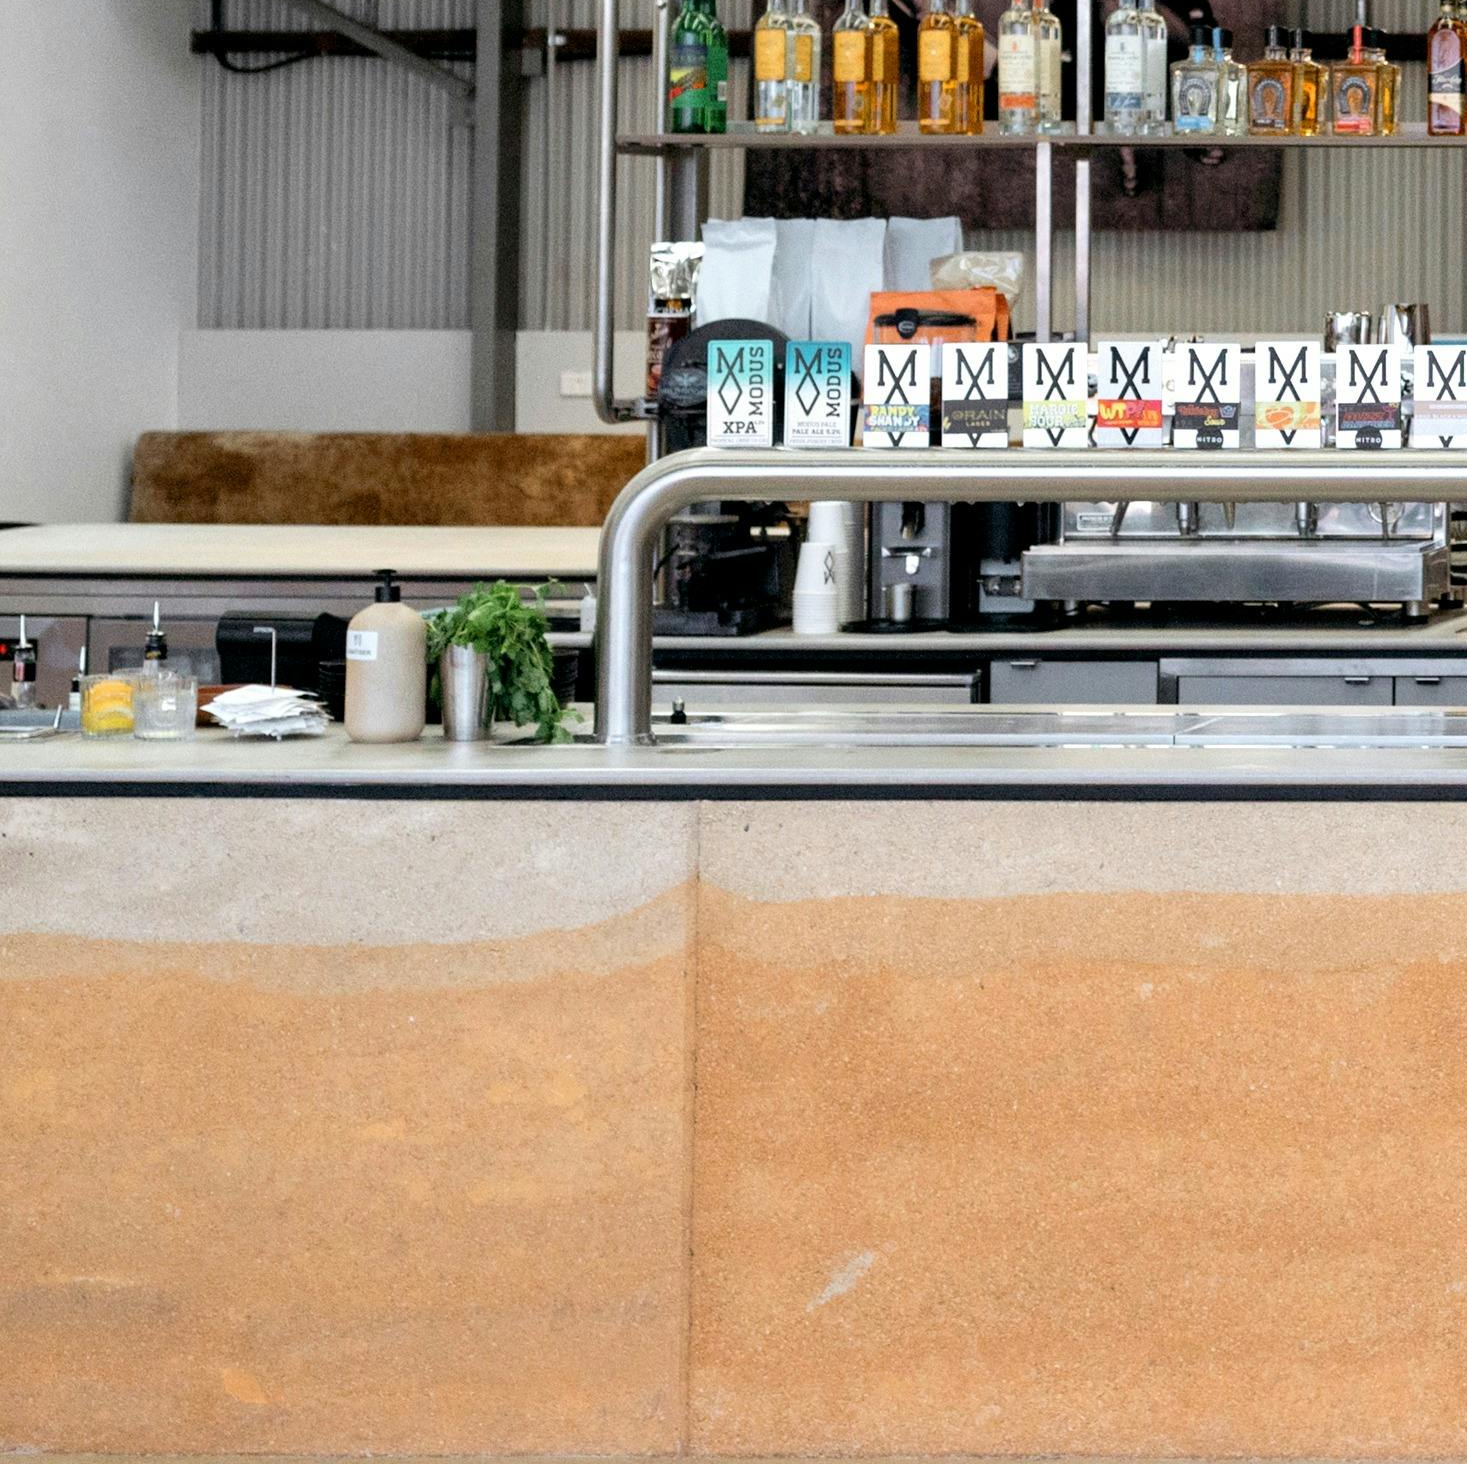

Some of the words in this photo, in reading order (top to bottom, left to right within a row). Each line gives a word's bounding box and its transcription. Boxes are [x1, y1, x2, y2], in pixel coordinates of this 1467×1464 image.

[748, 347, 764, 416] MODUS
[826, 347, 842, 418] MODUS
[723, 421, 757, 434] XPA
